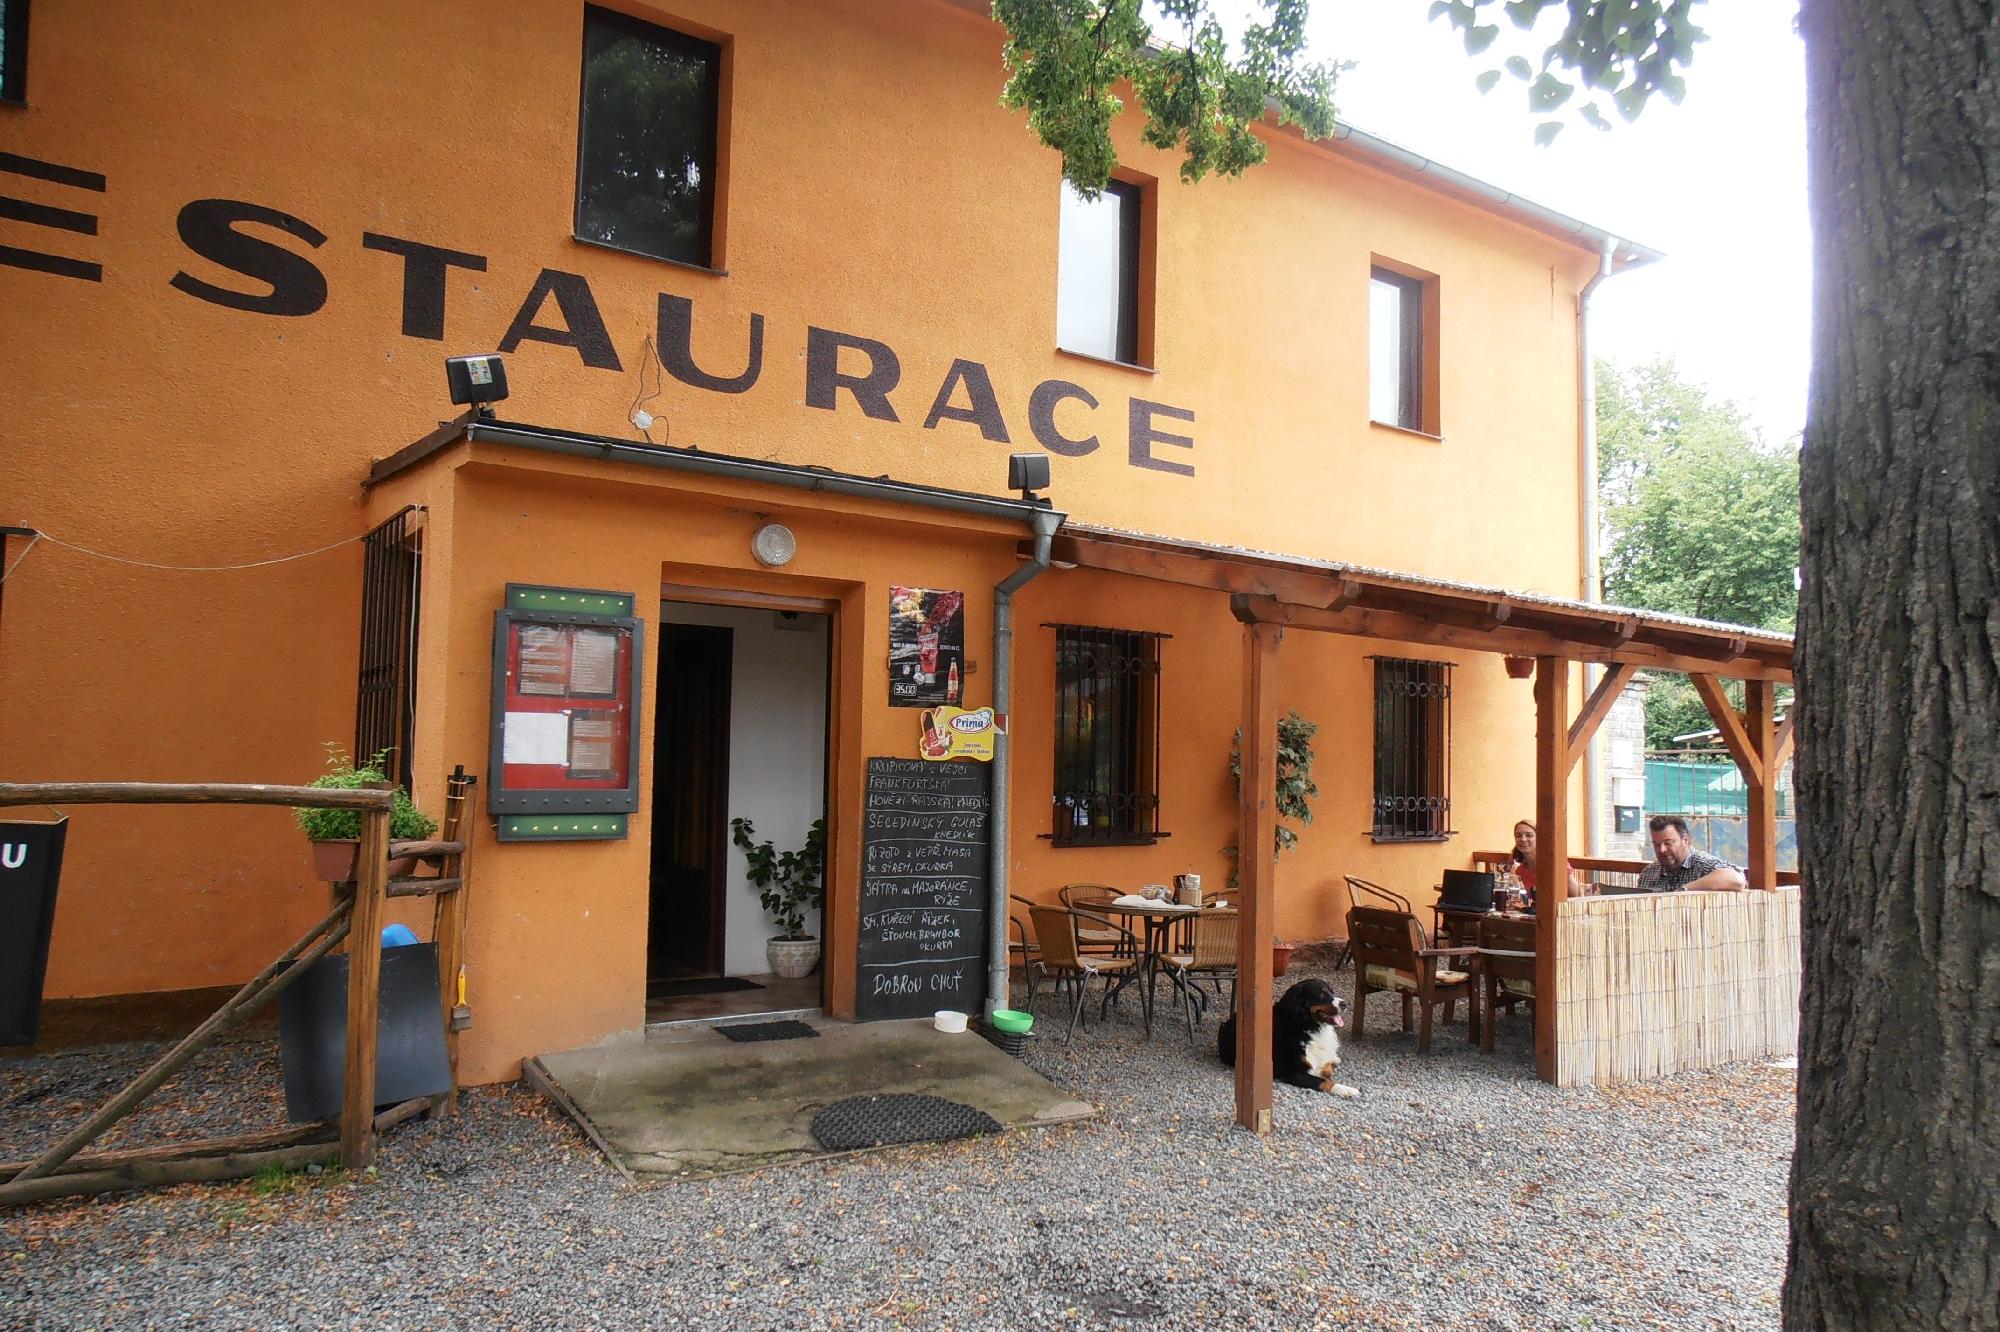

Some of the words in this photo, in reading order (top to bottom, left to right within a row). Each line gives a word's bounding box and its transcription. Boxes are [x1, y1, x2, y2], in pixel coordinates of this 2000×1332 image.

[956, 718, 983, 729] Prima
[915, 861, 953, 872] OKURKA
[866, 880, 898, 896] JÁTRA
[920, 940, 953, 951] OKURKA
[930, 965, 965, 992] CHUŤ
